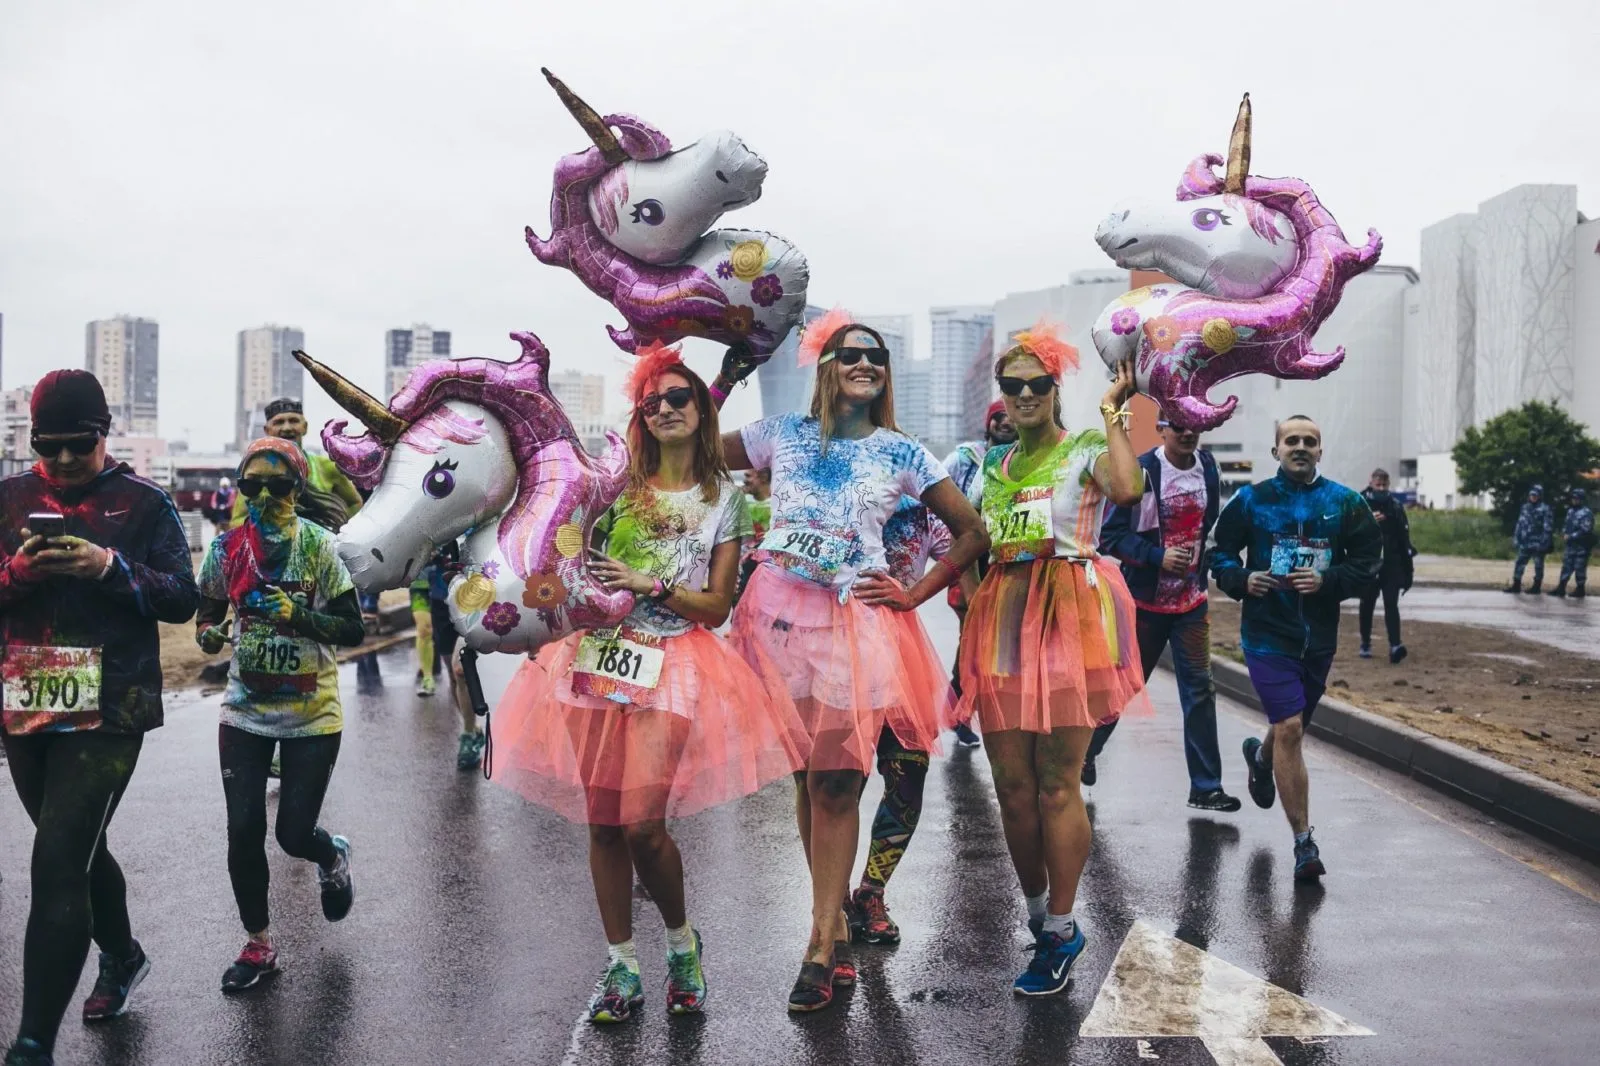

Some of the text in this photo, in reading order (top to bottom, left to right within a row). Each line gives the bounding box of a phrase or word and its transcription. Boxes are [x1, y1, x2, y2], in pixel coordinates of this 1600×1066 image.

[782, 532, 824, 559] 948
[255, 643, 301, 671] 2195
[596, 645, 643, 680] 1881
[19, 674, 79, 709] 3790
